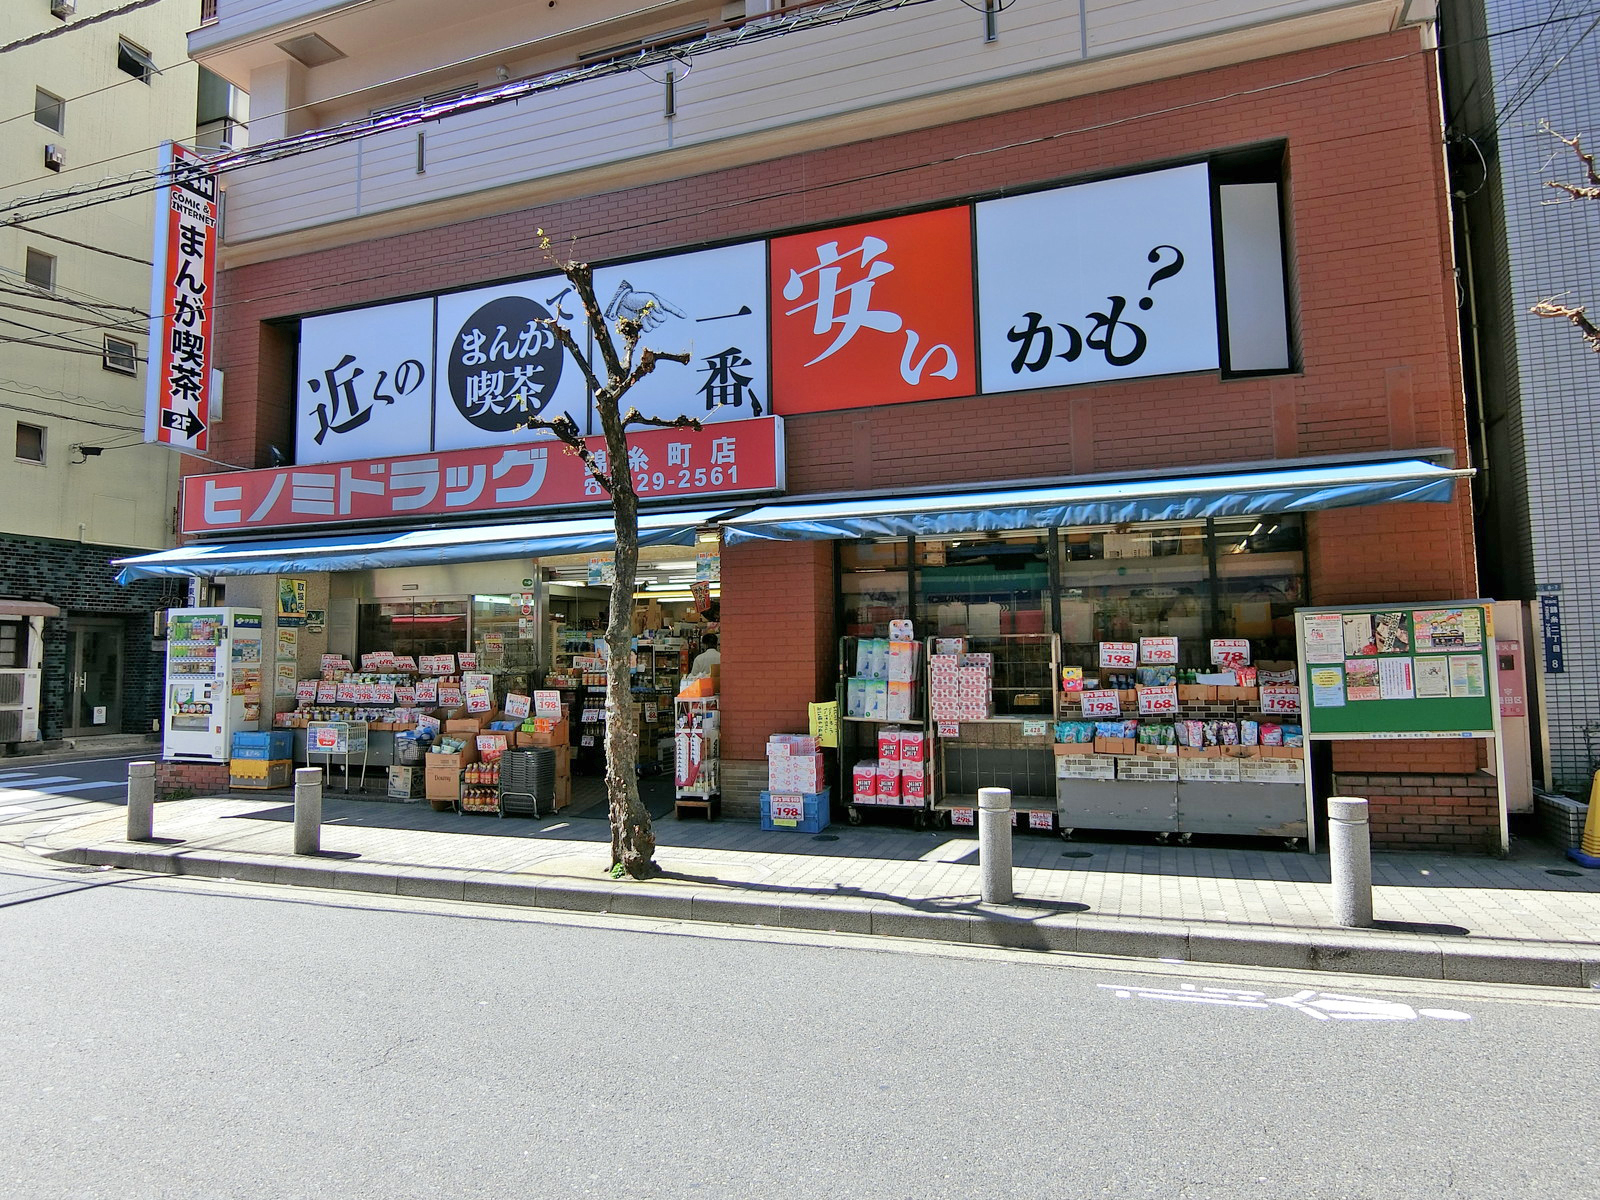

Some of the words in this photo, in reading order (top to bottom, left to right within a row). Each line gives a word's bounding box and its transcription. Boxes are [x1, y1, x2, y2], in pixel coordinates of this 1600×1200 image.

[172, 192, 201, 211] COMIC
[202, 205, 211, 215] &
[172, 200, 216, 228] INTERNET
[170, 224, 206, 402] まんが喫茶
[783, 236, 958, 386] 安い
[695, 305, 754, 411] 一番
[307, 354, 425, 446] 近くの
[466, 365, 545, 418] 喫茶
[171, 414, 191, 431] 2F
[204, 446, 548, 524] ヒノミドラッグ
[606, 464, 738, 494] 29-2561
[1107, 654, 1131, 664] 198
[1147, 650, 1171, 659] 198
[1218, 651, 1244, 661] 78
[1551, 659, 1559, 668] 8
[471, 700, 486, 708] 98
[1089, 702, 1113, 712] 198
[1146, 699, 1172, 710] 168
[1268, 699, 1296, 709] 198
[777, 807, 799, 817] 198
